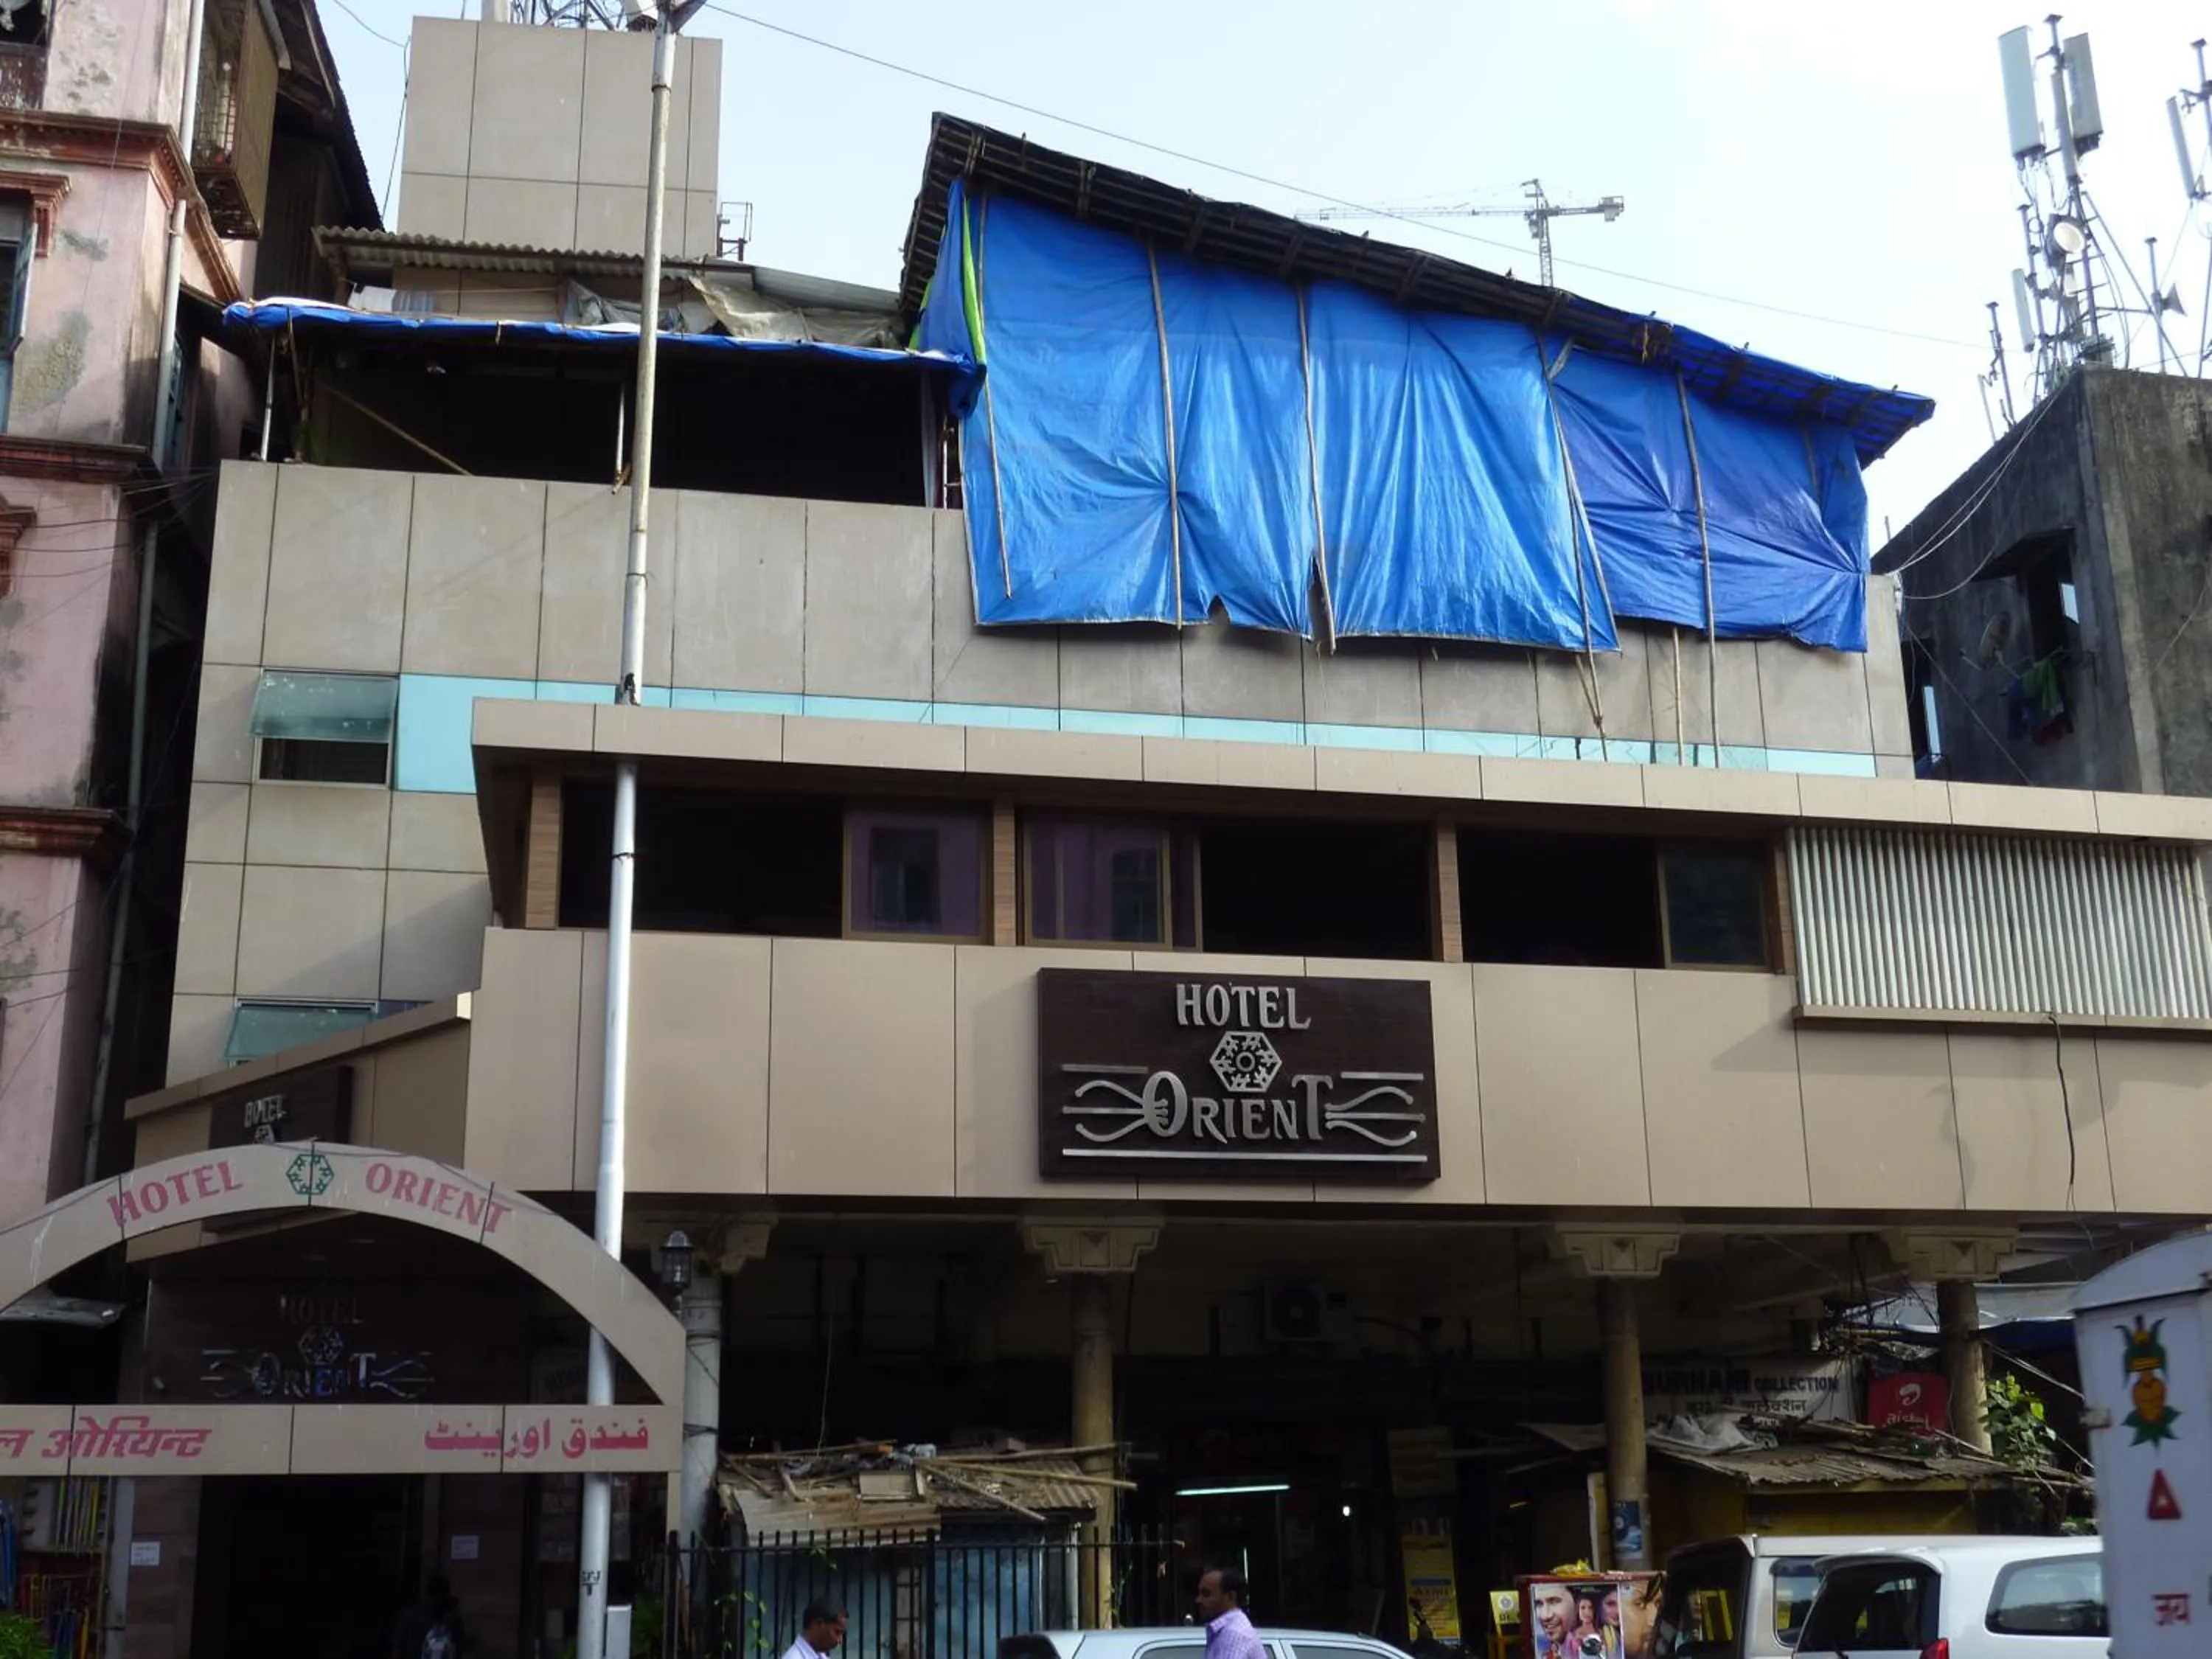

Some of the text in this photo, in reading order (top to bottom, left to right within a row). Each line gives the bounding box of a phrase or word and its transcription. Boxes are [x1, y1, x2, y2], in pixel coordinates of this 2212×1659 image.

[1175, 983, 1312, 1029] HOTEL
[1142, 1071, 1333, 1144] ORIENT
[107, 1161, 512, 1234] HOTEL ORIENT
[279, 1295, 366, 1324] HOTEL
[1754, 1375, 1840, 1393] COLLECTION
[562, 1417, 649, 1459] فندق
[2152, 1593, 2191, 1627] जय
